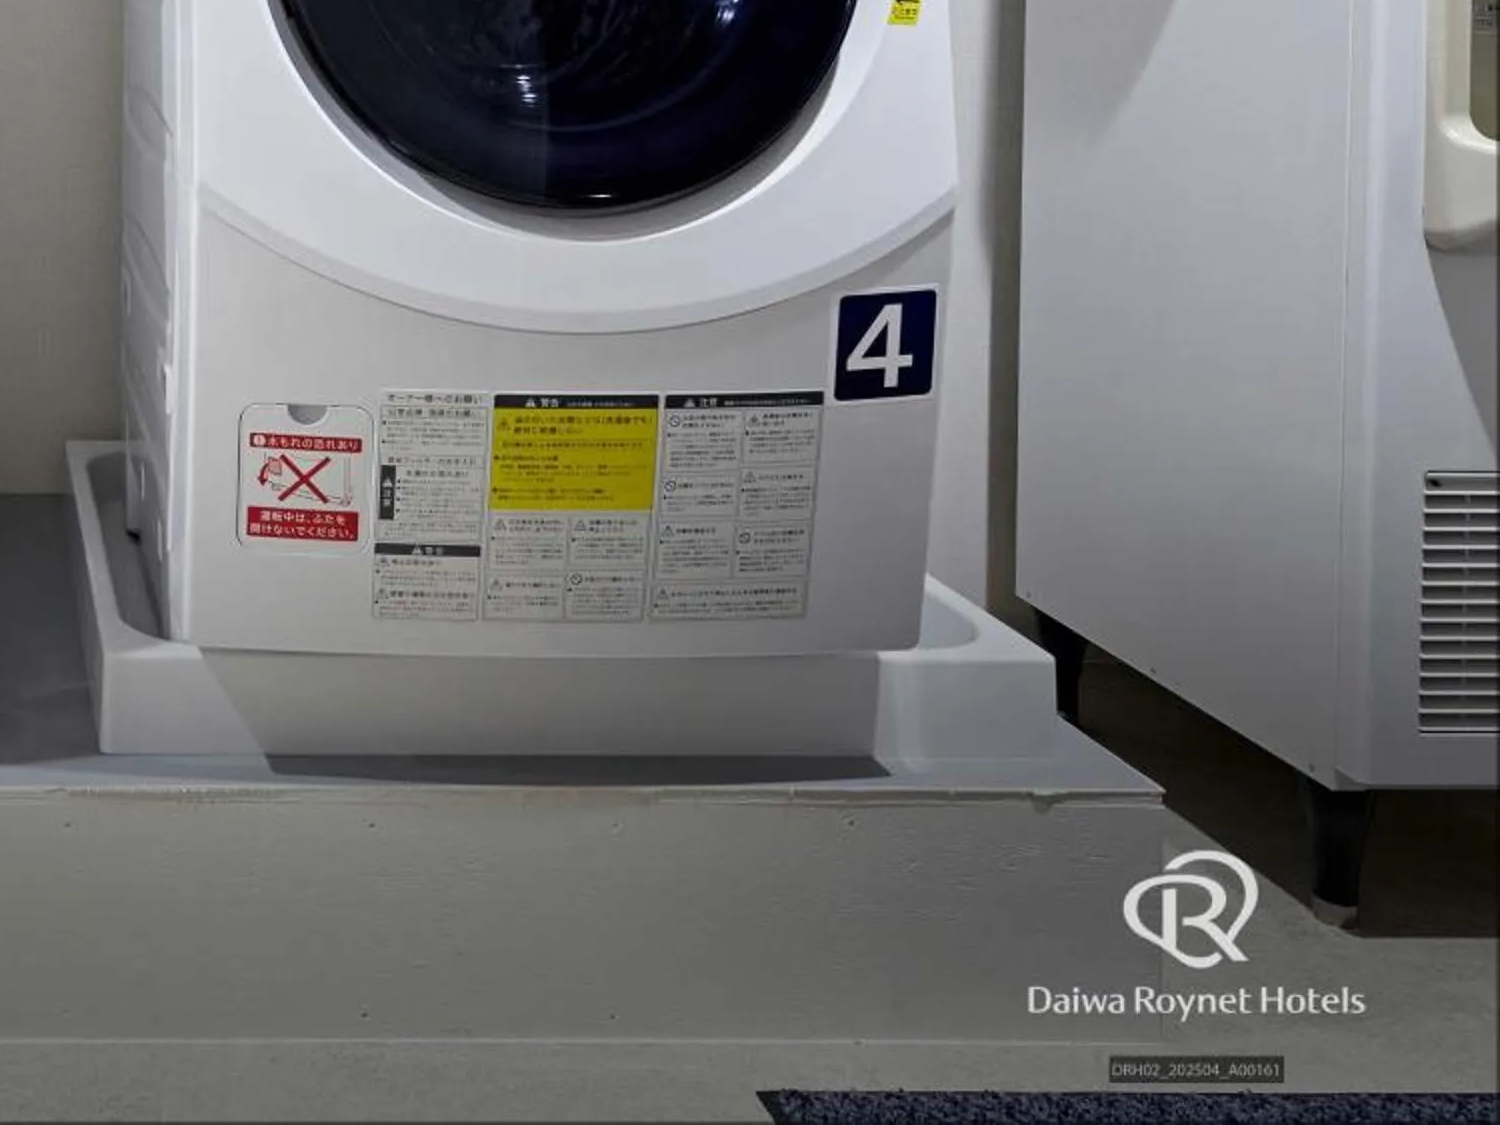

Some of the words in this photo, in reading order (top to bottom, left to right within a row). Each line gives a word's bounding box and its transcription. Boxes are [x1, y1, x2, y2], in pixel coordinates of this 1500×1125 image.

[846, 303, 913, 387] 4
[267, 436, 358, 451] 水もれの恐れあり
[249, 524, 355, 539] 開けないでください。
